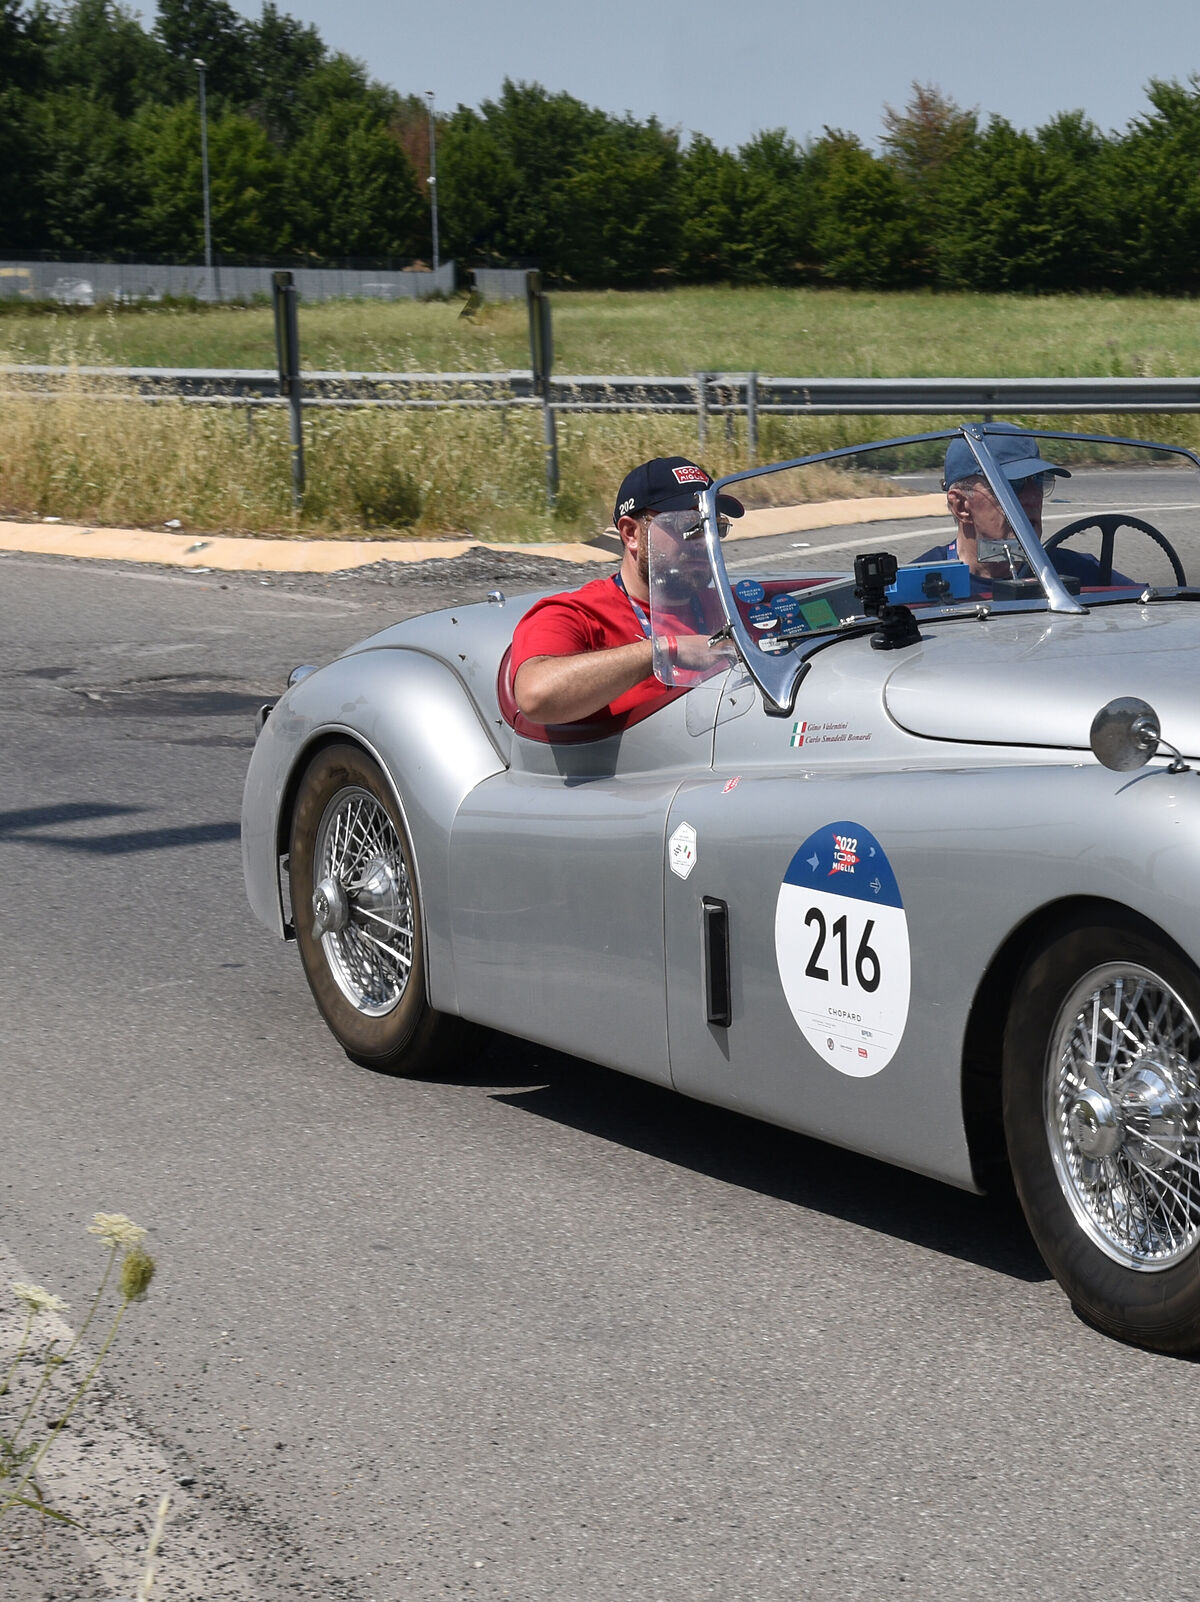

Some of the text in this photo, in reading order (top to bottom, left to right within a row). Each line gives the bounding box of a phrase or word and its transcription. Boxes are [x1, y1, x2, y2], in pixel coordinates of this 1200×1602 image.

[619, 498, 636, 516] 202
[807, 721, 849, 732] Gino Valentini
[805, 735, 821, 744] Carlo
[847, 732, 873, 741] Bonardi
[834, 835, 858, 853] 2022
[833, 851, 856, 863] 1000
[832, 861, 855, 874] MIGLIA
[804, 907, 881, 994] 216
[828, 1007, 862, 1022] CHOPARD
